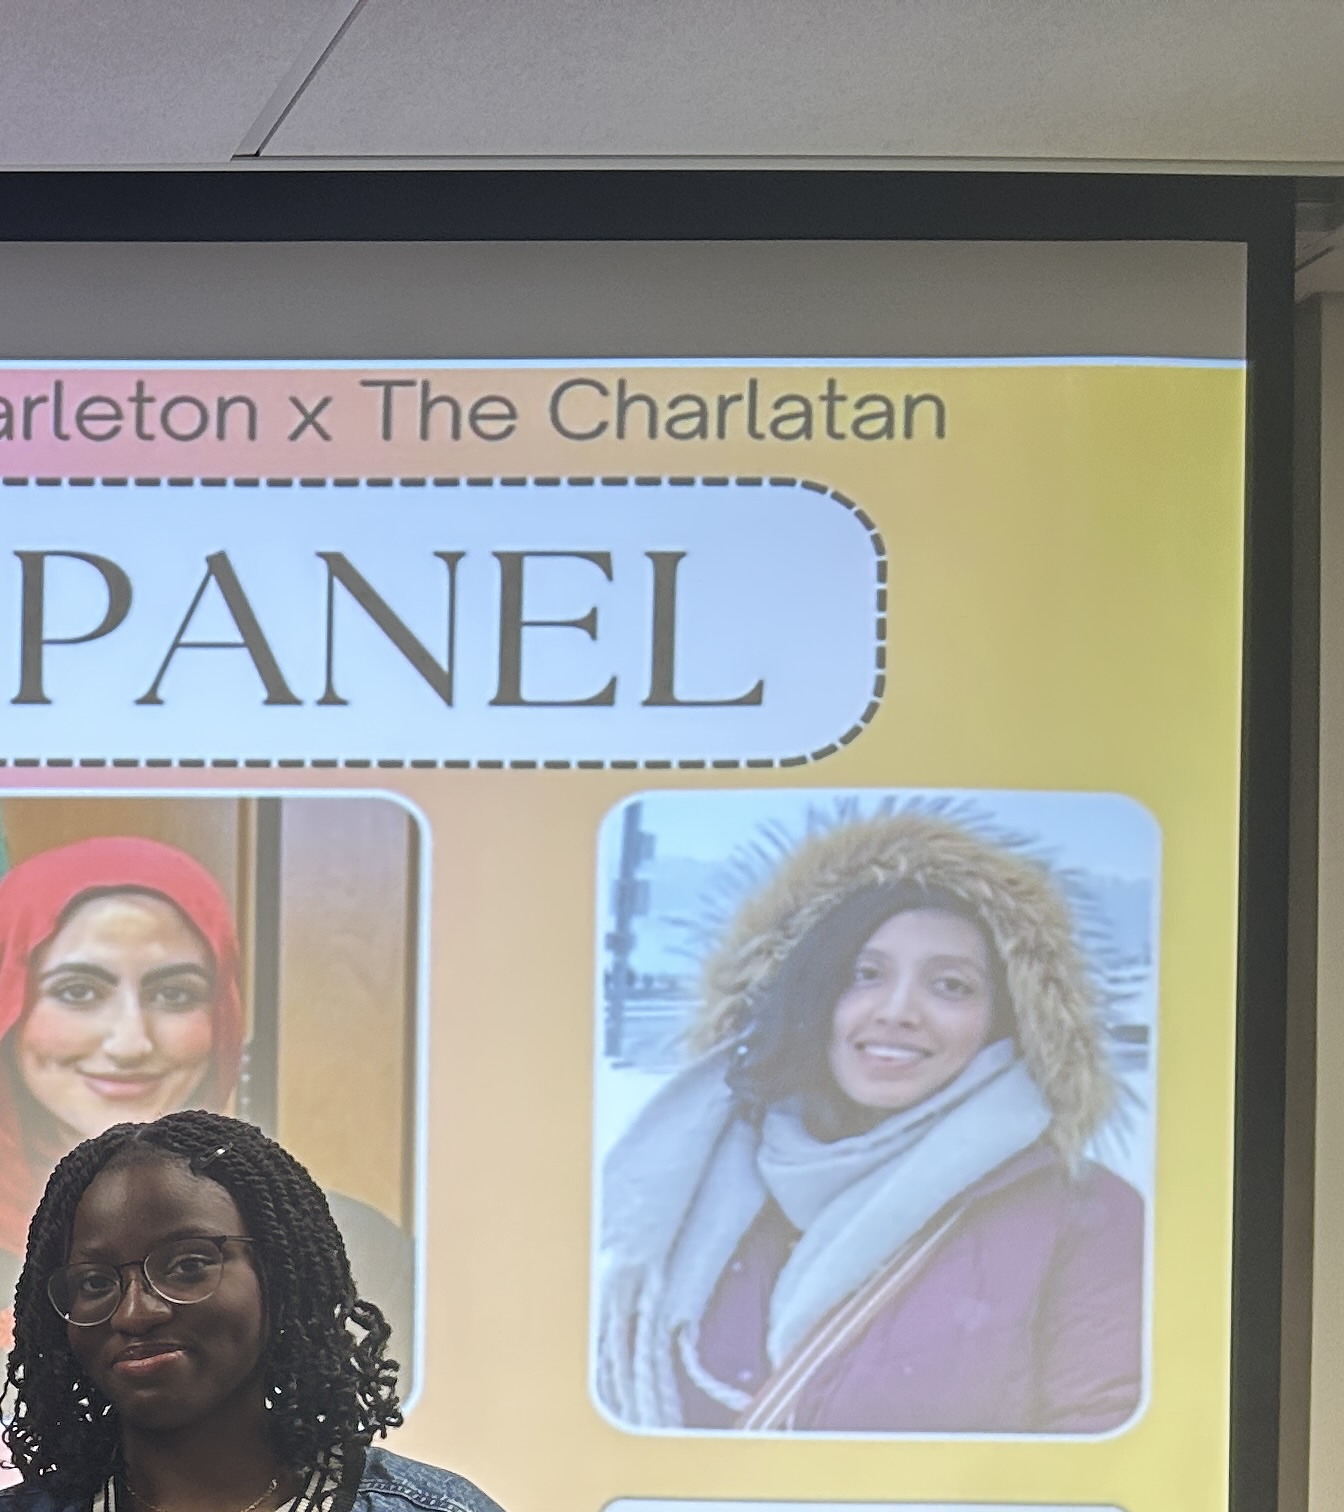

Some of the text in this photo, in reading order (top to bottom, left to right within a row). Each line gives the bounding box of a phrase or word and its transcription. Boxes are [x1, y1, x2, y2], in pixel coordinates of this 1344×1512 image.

[288, 394, 333, 442] x
[360, 378, 518, 442] The
[549, 377, 948, 443] Charlatan
[10, 547, 765, 709] PANEL
